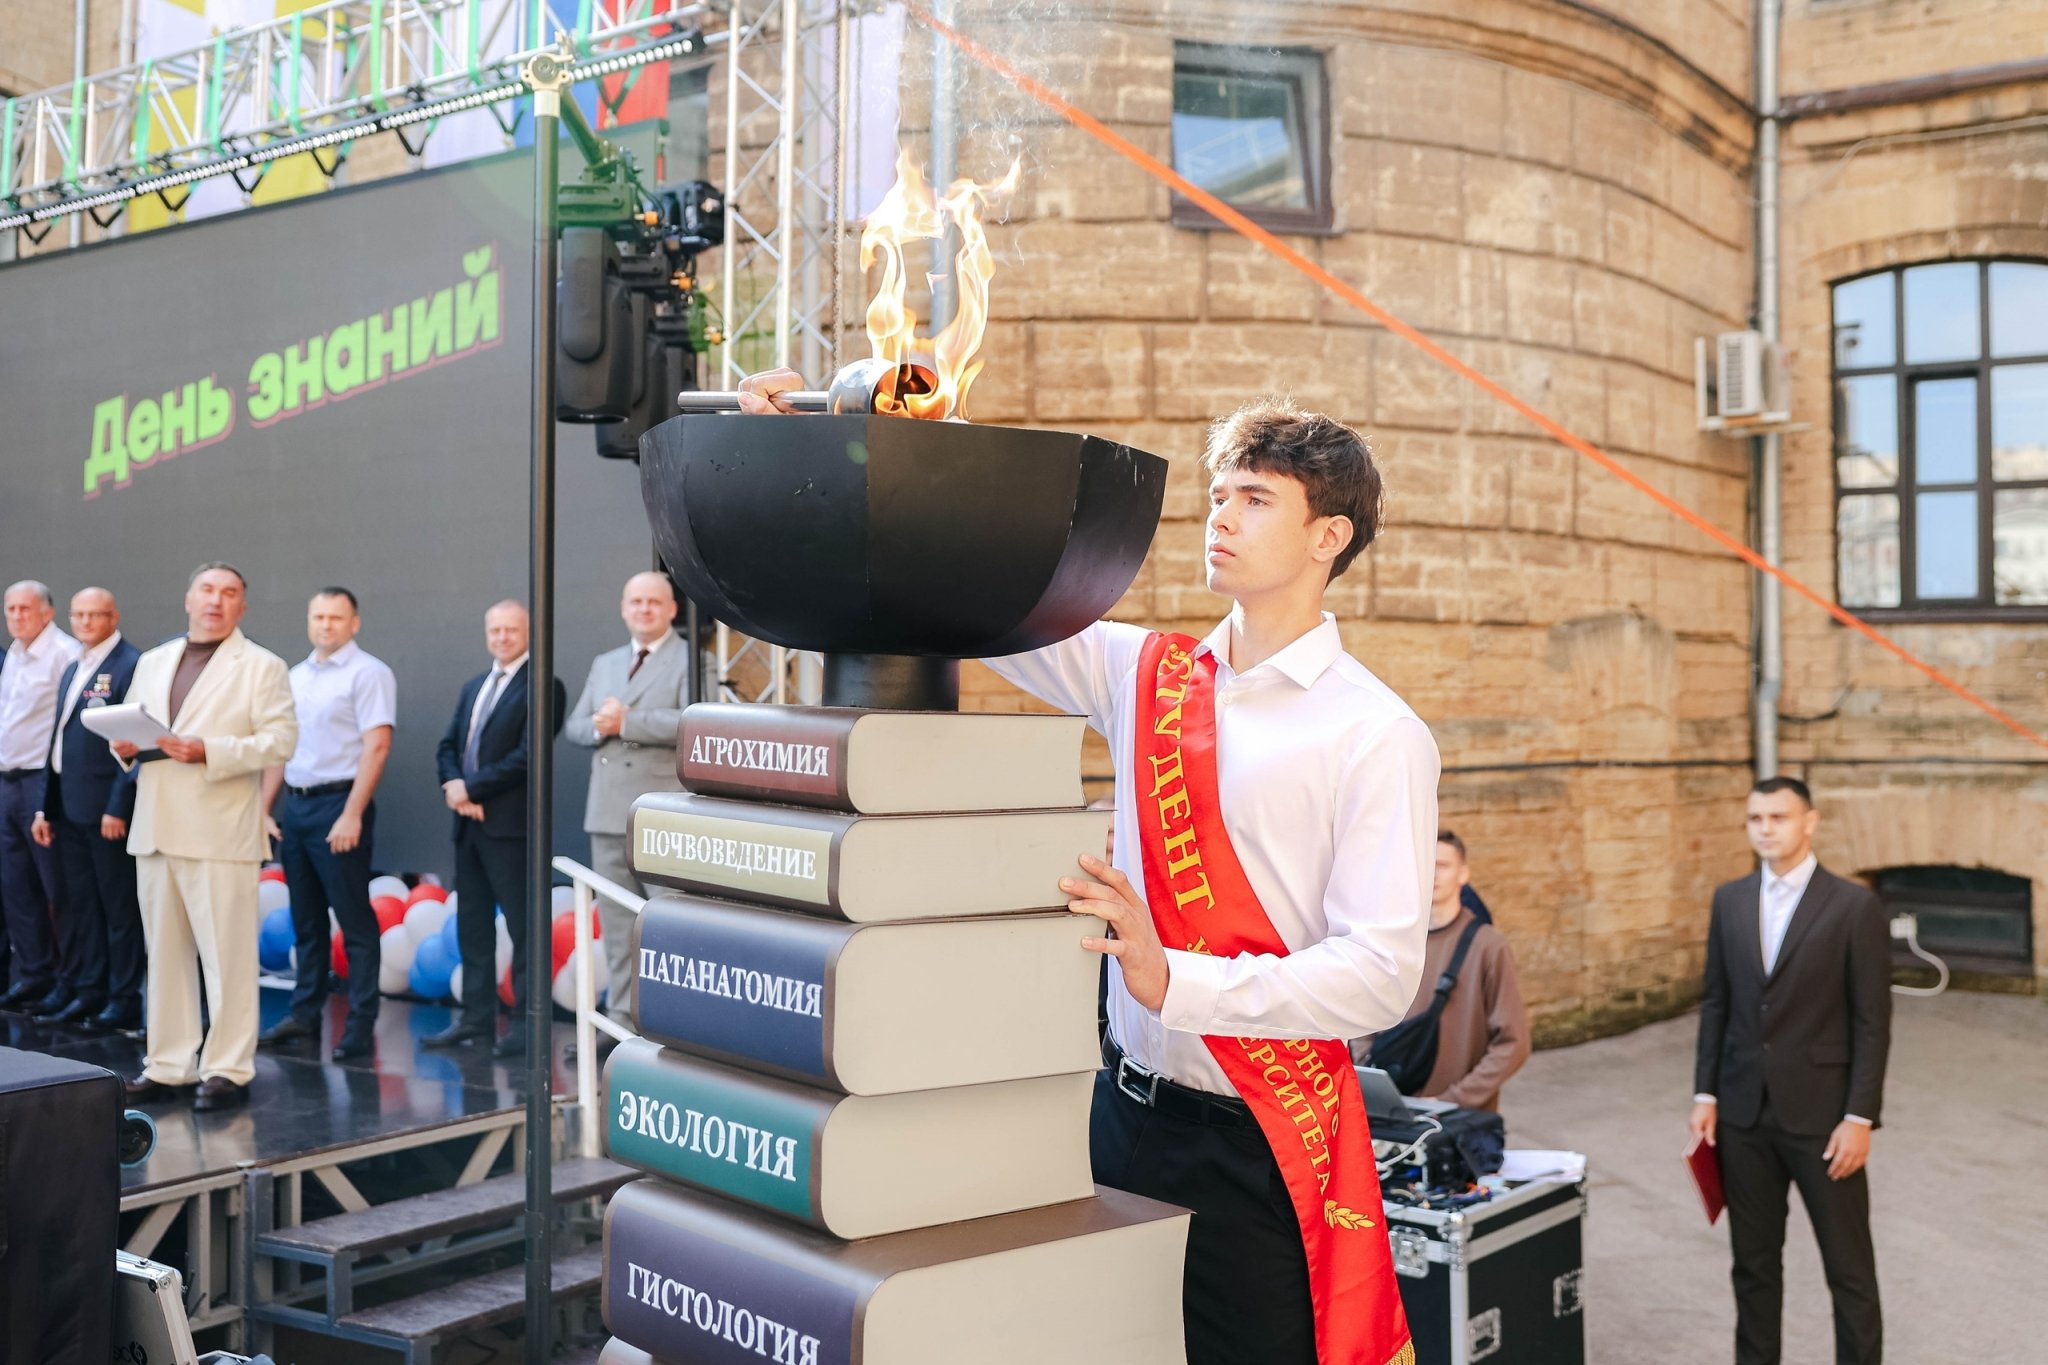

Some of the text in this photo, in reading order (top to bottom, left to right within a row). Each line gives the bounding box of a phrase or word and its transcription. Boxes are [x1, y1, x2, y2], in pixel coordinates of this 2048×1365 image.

[84, 244, 501, 496] День знаний
[689, 735, 829, 777] АГРОХИМИЯ
[1148, 656, 1216, 911] СТУДЕНТ
[641, 828, 816, 880] ПОЧВОВЕДЕНИЕ
[639, 947, 823, 1018] ПАТАНАТОМИЯ
[618, 1090, 798, 1182] ЭКОЛОГИЯ
[627, 1262, 821, 1365] ГИСТОЛОГИЯ
